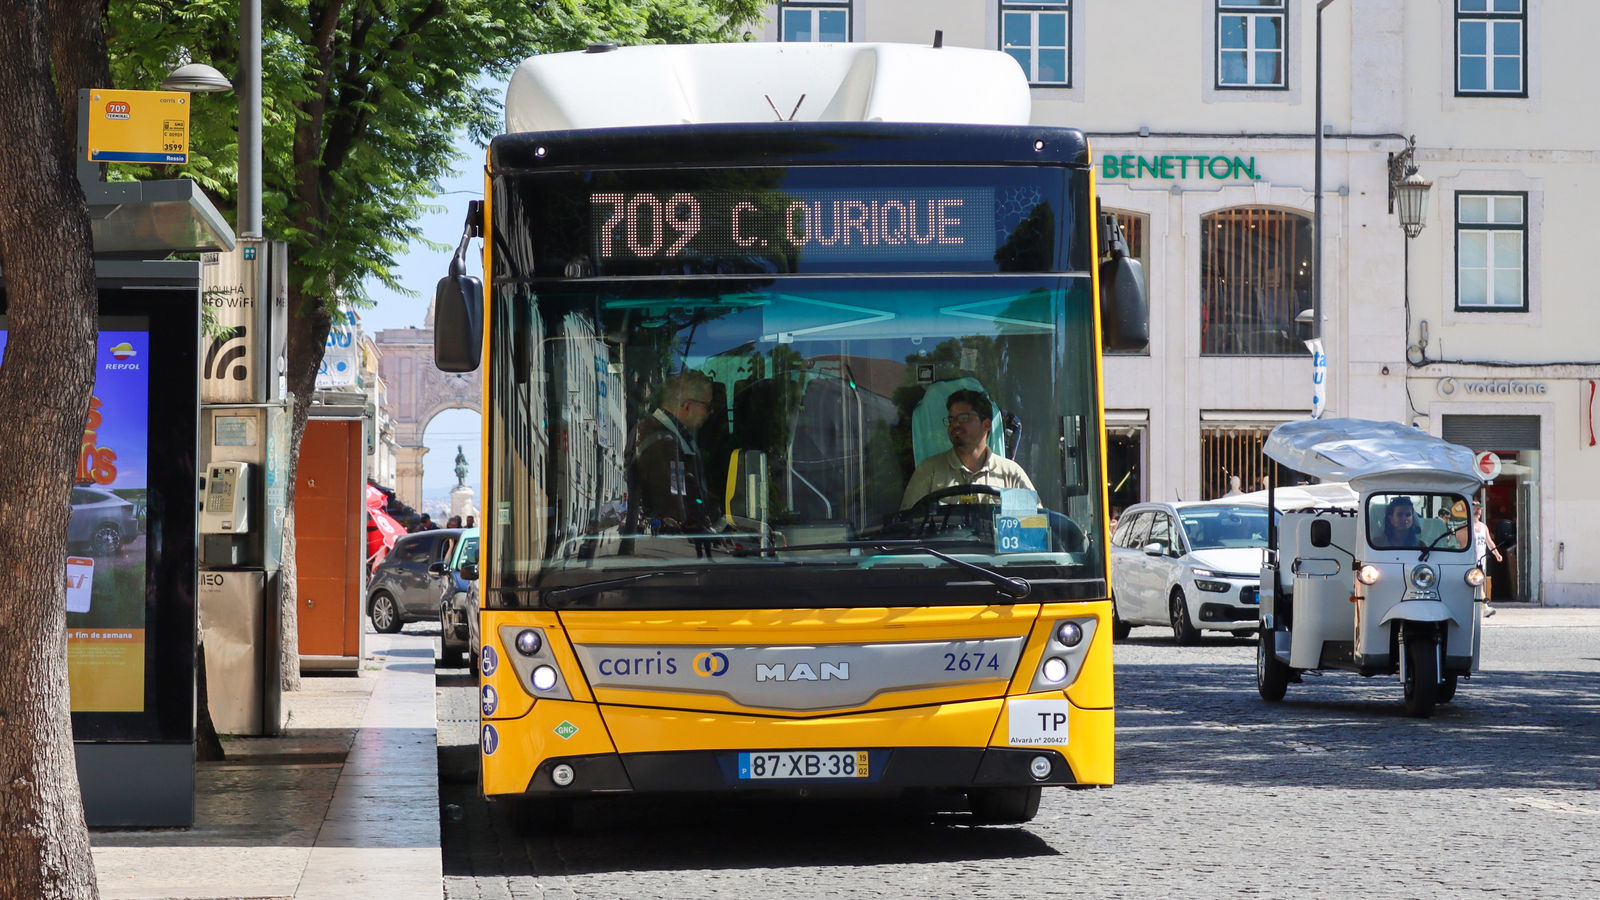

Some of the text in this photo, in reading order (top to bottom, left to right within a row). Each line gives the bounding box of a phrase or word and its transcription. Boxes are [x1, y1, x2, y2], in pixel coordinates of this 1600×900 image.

[109, 104, 127, 113] 709
[164, 143, 183, 151] 3599
[590, 192, 964, 258] 709 C. OURIQUE
[226, 297, 254, 308] WiFi
[105, 363, 140, 371] REPSOL
[1464, 379, 1549, 396] vodafone
[1000, 519, 1018, 529] 709
[1001, 536, 1019, 549] 03
[75, 631, 89, 639] fim
[90, 631, 100, 639] de
[599, 650, 677, 676] carris
[944, 652, 1000, 672] 2674
[755, 662, 849, 682] MAN
[1037, 712, 1067, 731] TP
[558, 726, 574, 734] GNC
[858, 754, 867, 762] 19
[858, 768, 868, 776] 02
